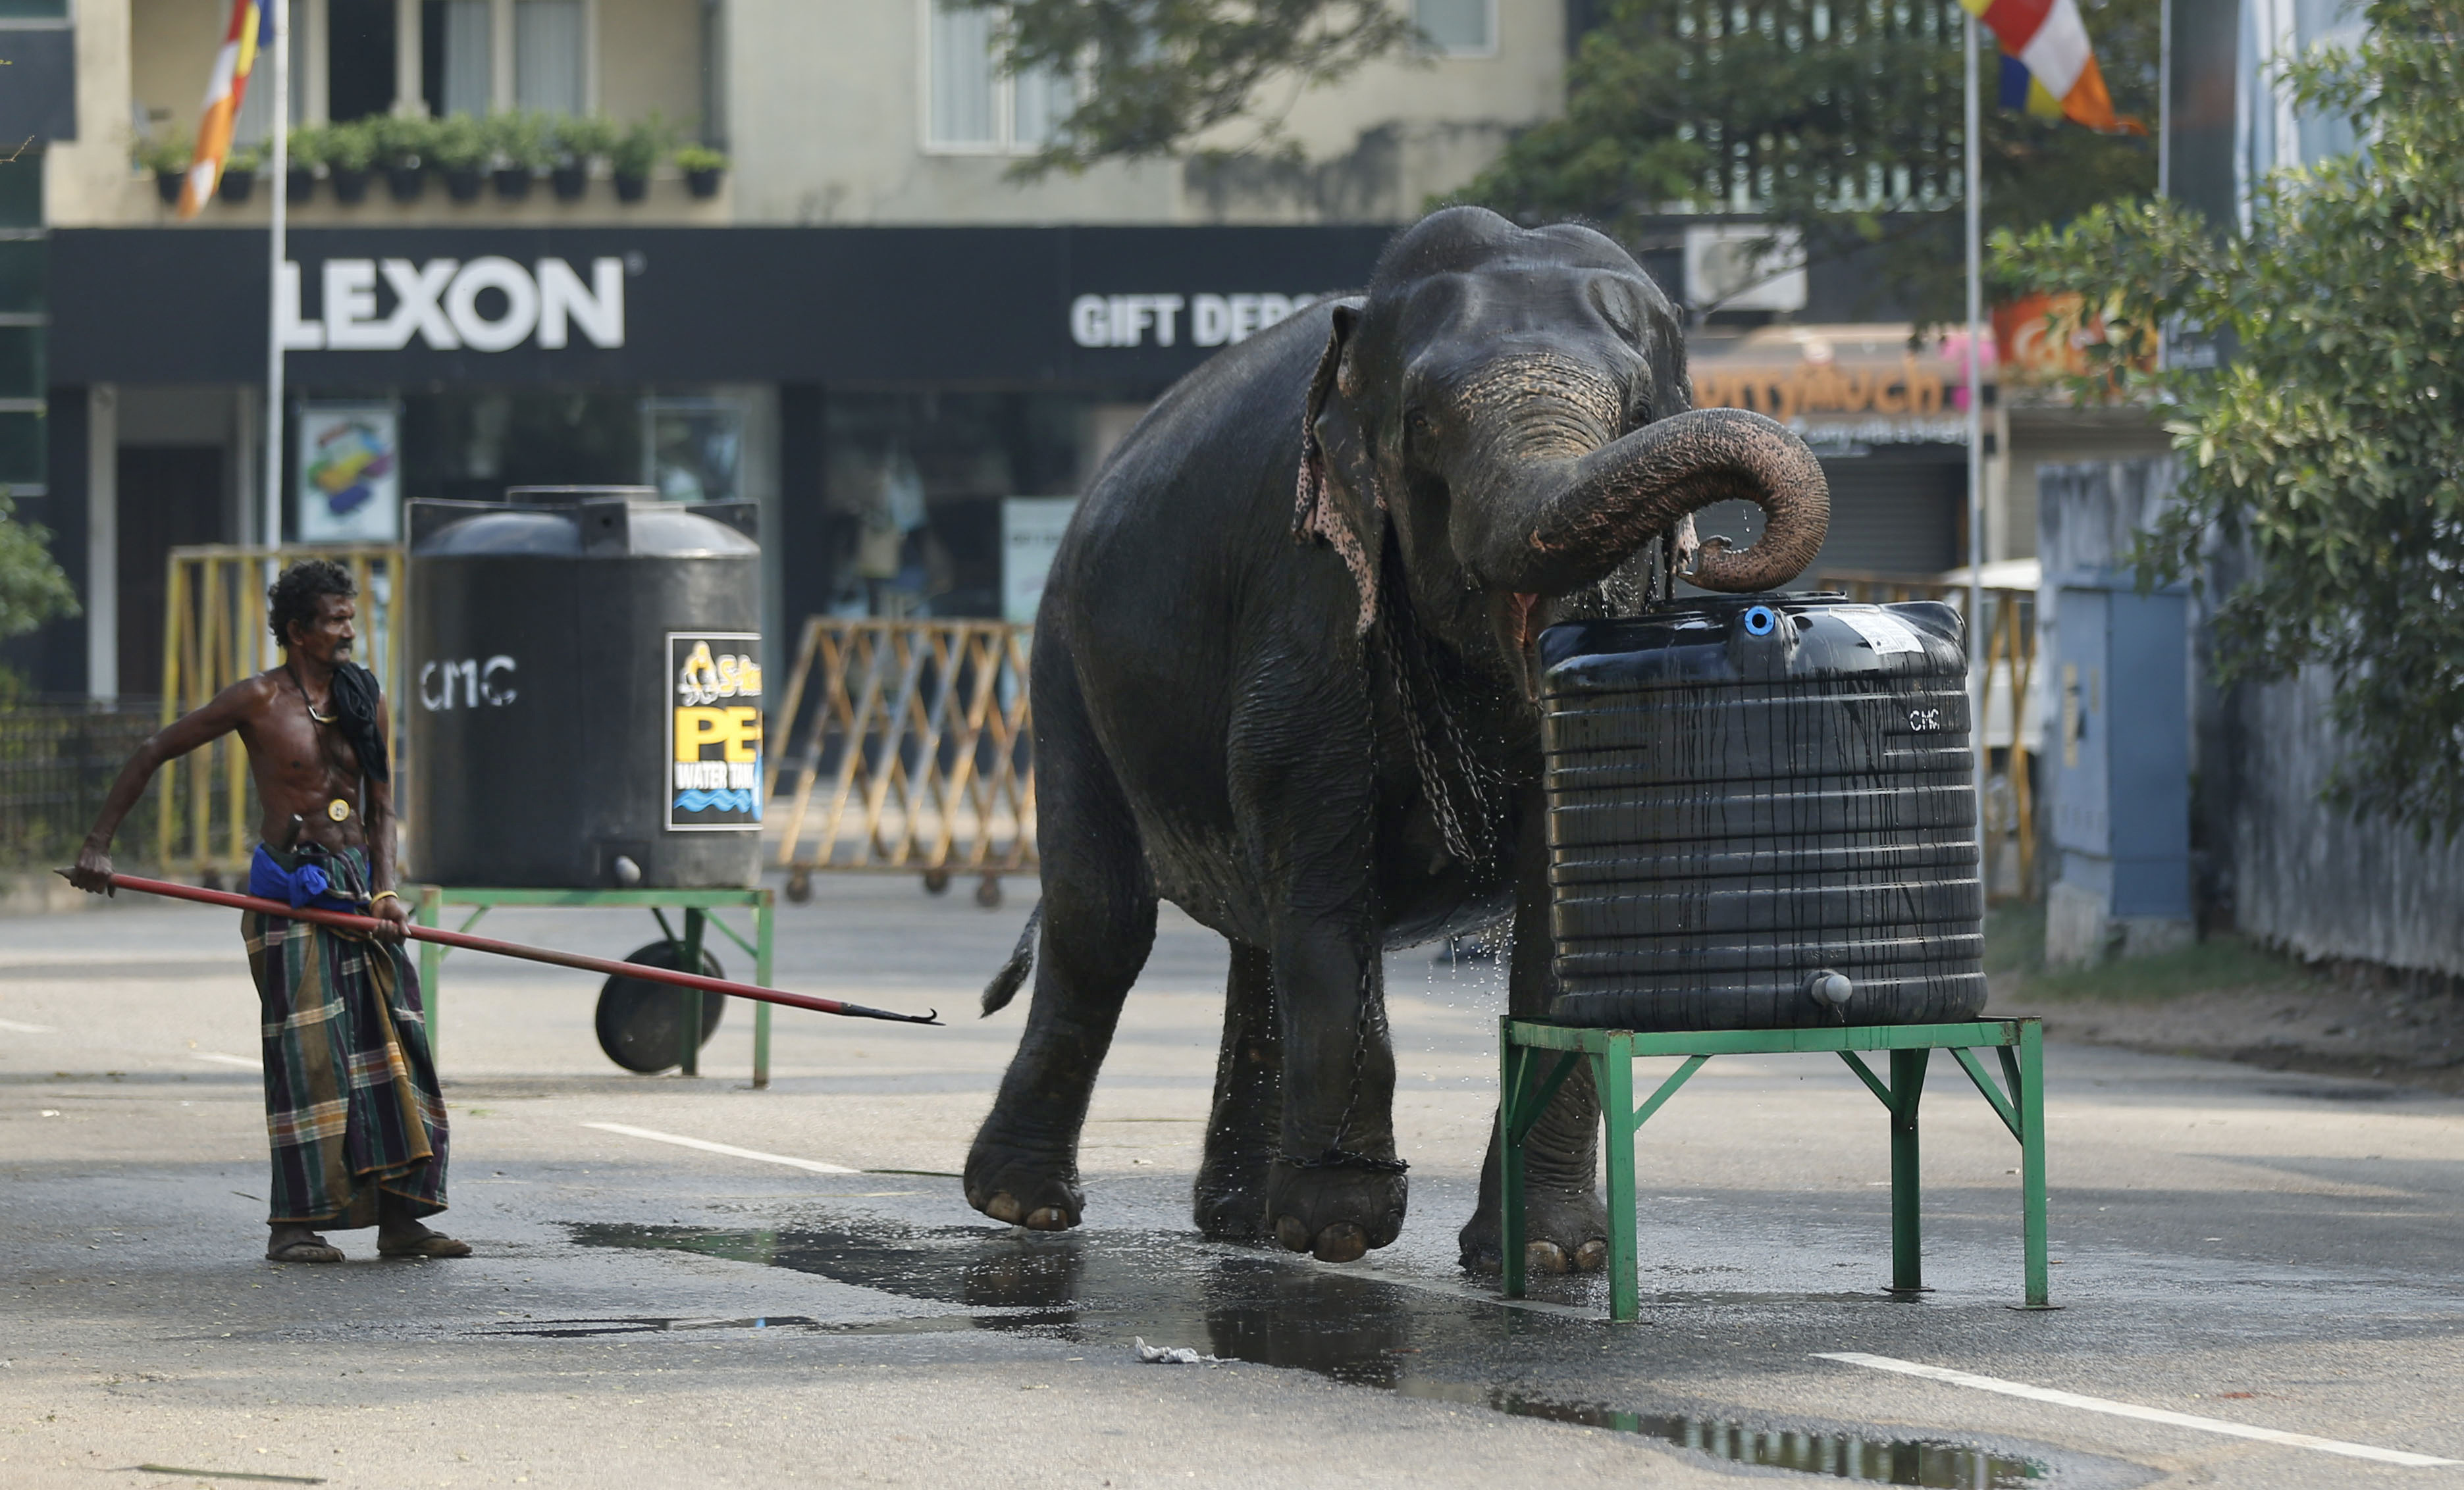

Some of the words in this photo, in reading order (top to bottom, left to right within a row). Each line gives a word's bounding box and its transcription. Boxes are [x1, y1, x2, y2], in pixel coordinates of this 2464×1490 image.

[275, 255, 625, 352] LEXON
[1071, 293, 1185, 347] GIFT
[420, 655, 517, 711] CMC
[1910, 708, 1940, 731] CMC
[674, 761, 727, 789] WATER
